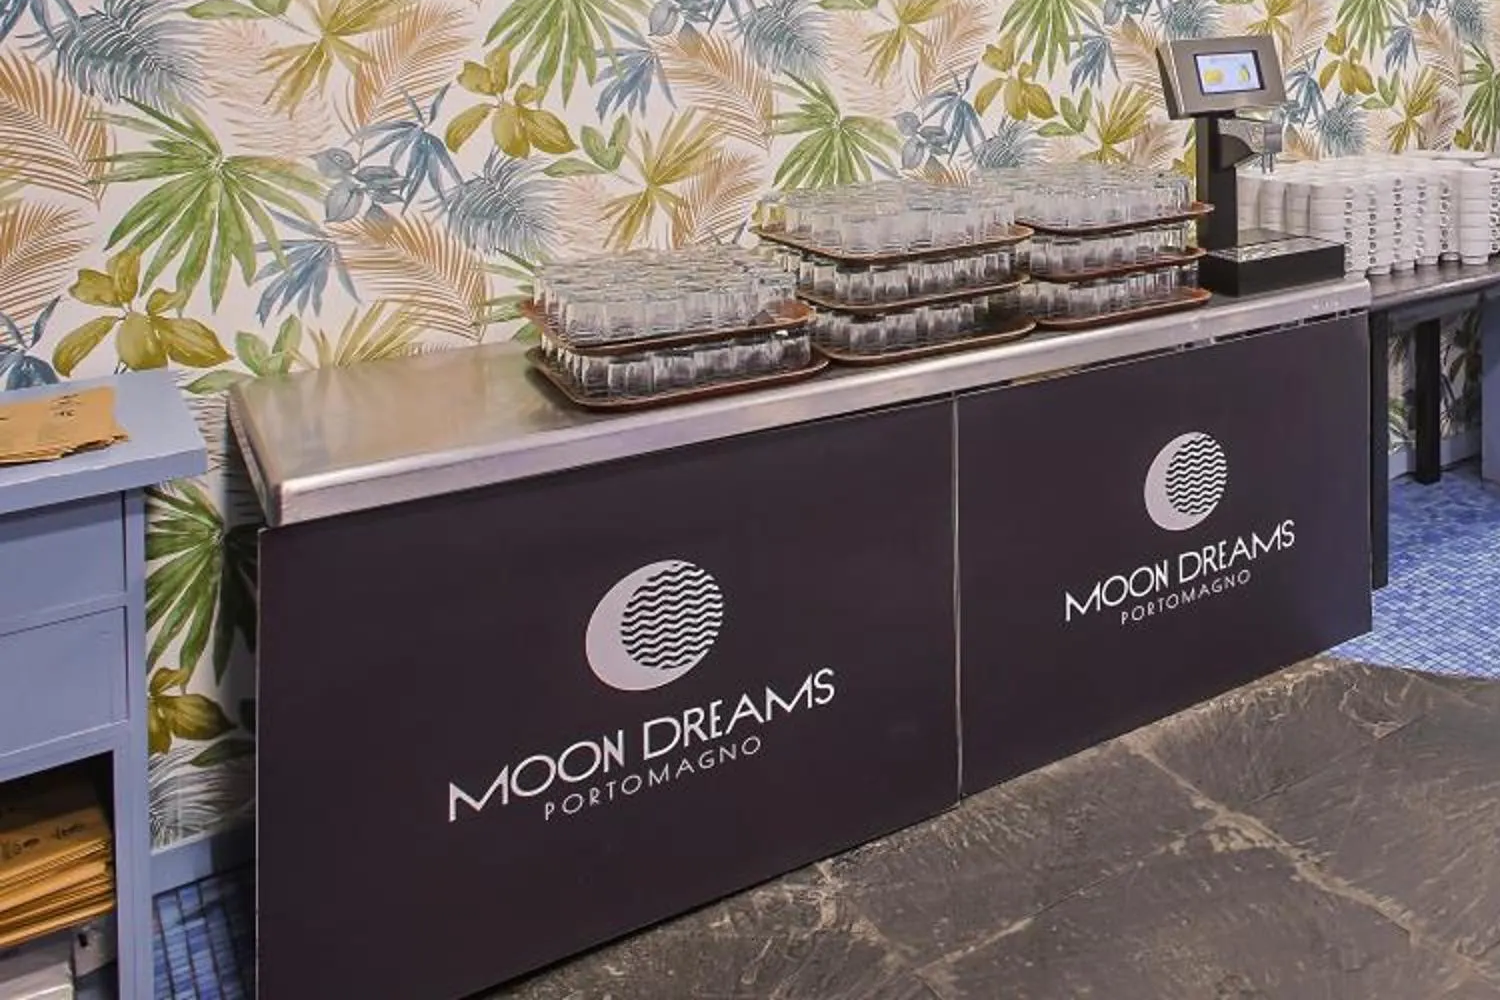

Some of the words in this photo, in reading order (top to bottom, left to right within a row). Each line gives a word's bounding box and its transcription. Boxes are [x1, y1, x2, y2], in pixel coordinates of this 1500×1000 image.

[1064, 559, 1169, 623] MOON
[1178, 519, 1296, 584] DREAMS
[1120, 569, 1251, 625] PORTOMAGNO
[448, 729, 625, 823] MOON
[642, 667, 836, 761] DREAMS
[544, 735, 762, 821] PORTOMAGNO
